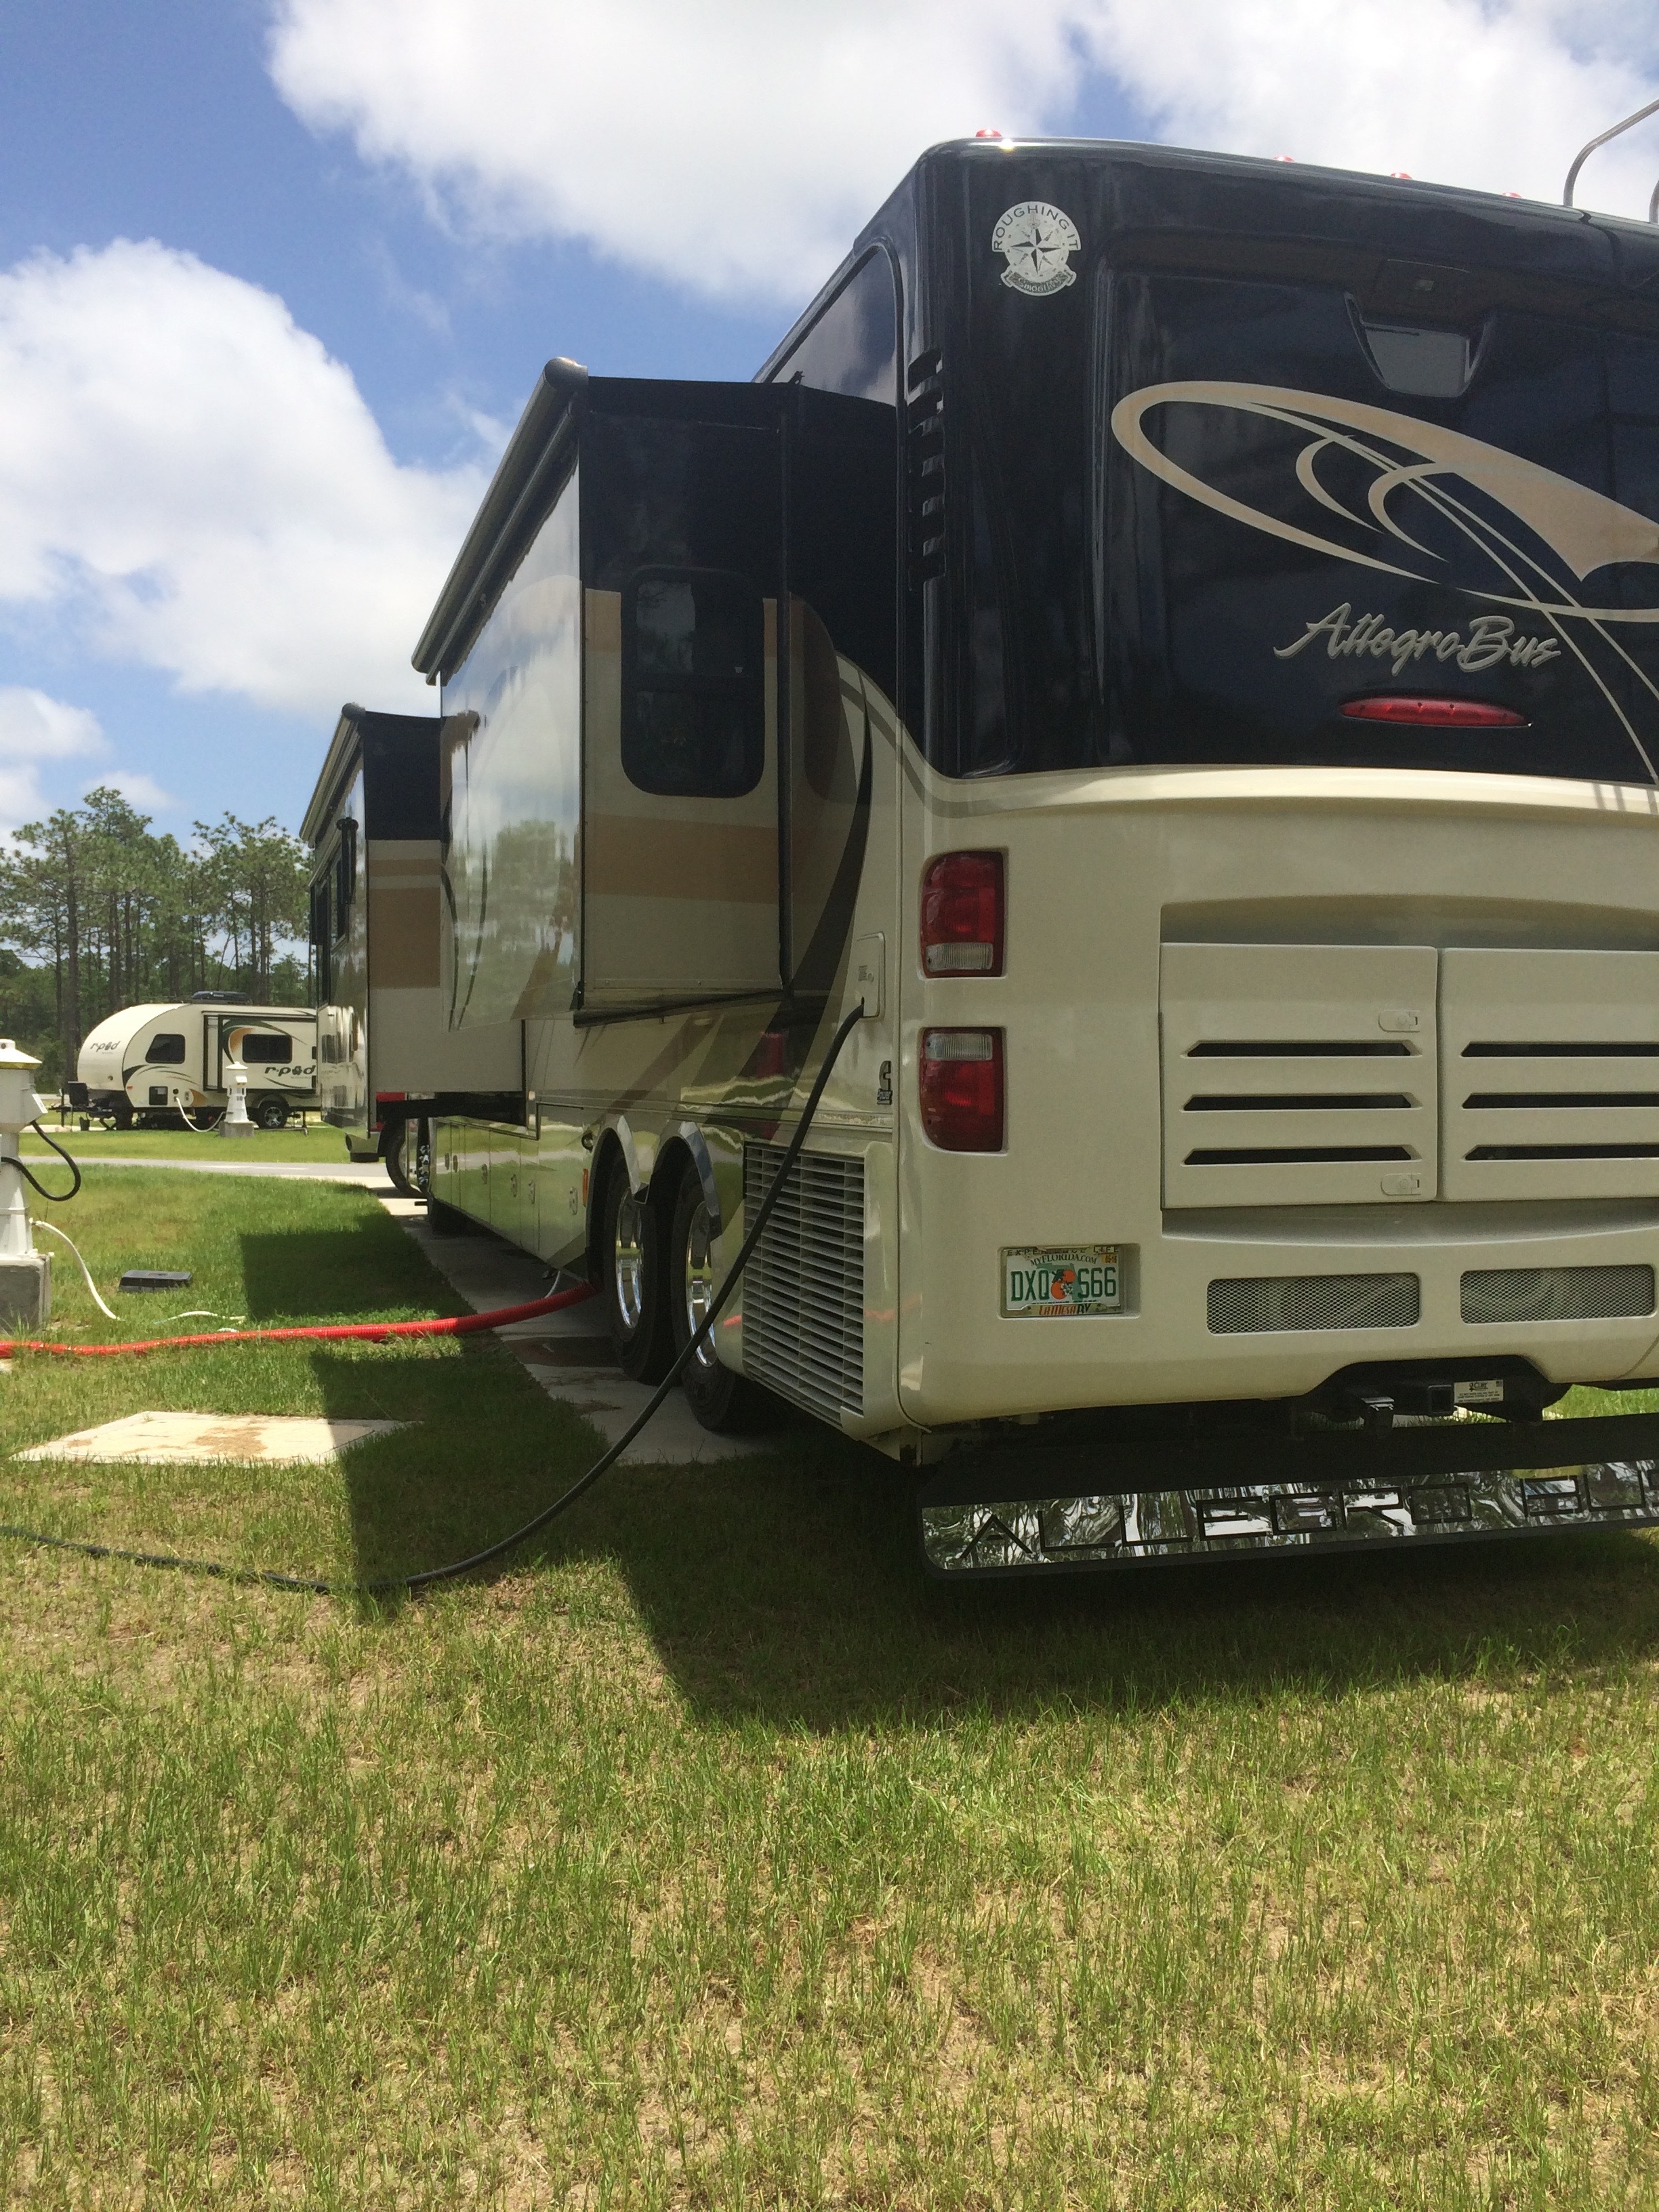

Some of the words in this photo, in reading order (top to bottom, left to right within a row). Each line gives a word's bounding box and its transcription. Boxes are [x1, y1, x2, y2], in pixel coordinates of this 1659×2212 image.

[994, 205, 1070, 251] ROUGHING
[1067, 233, 1079, 250] IT
[1519, 1467, 1659, 1519] BU
